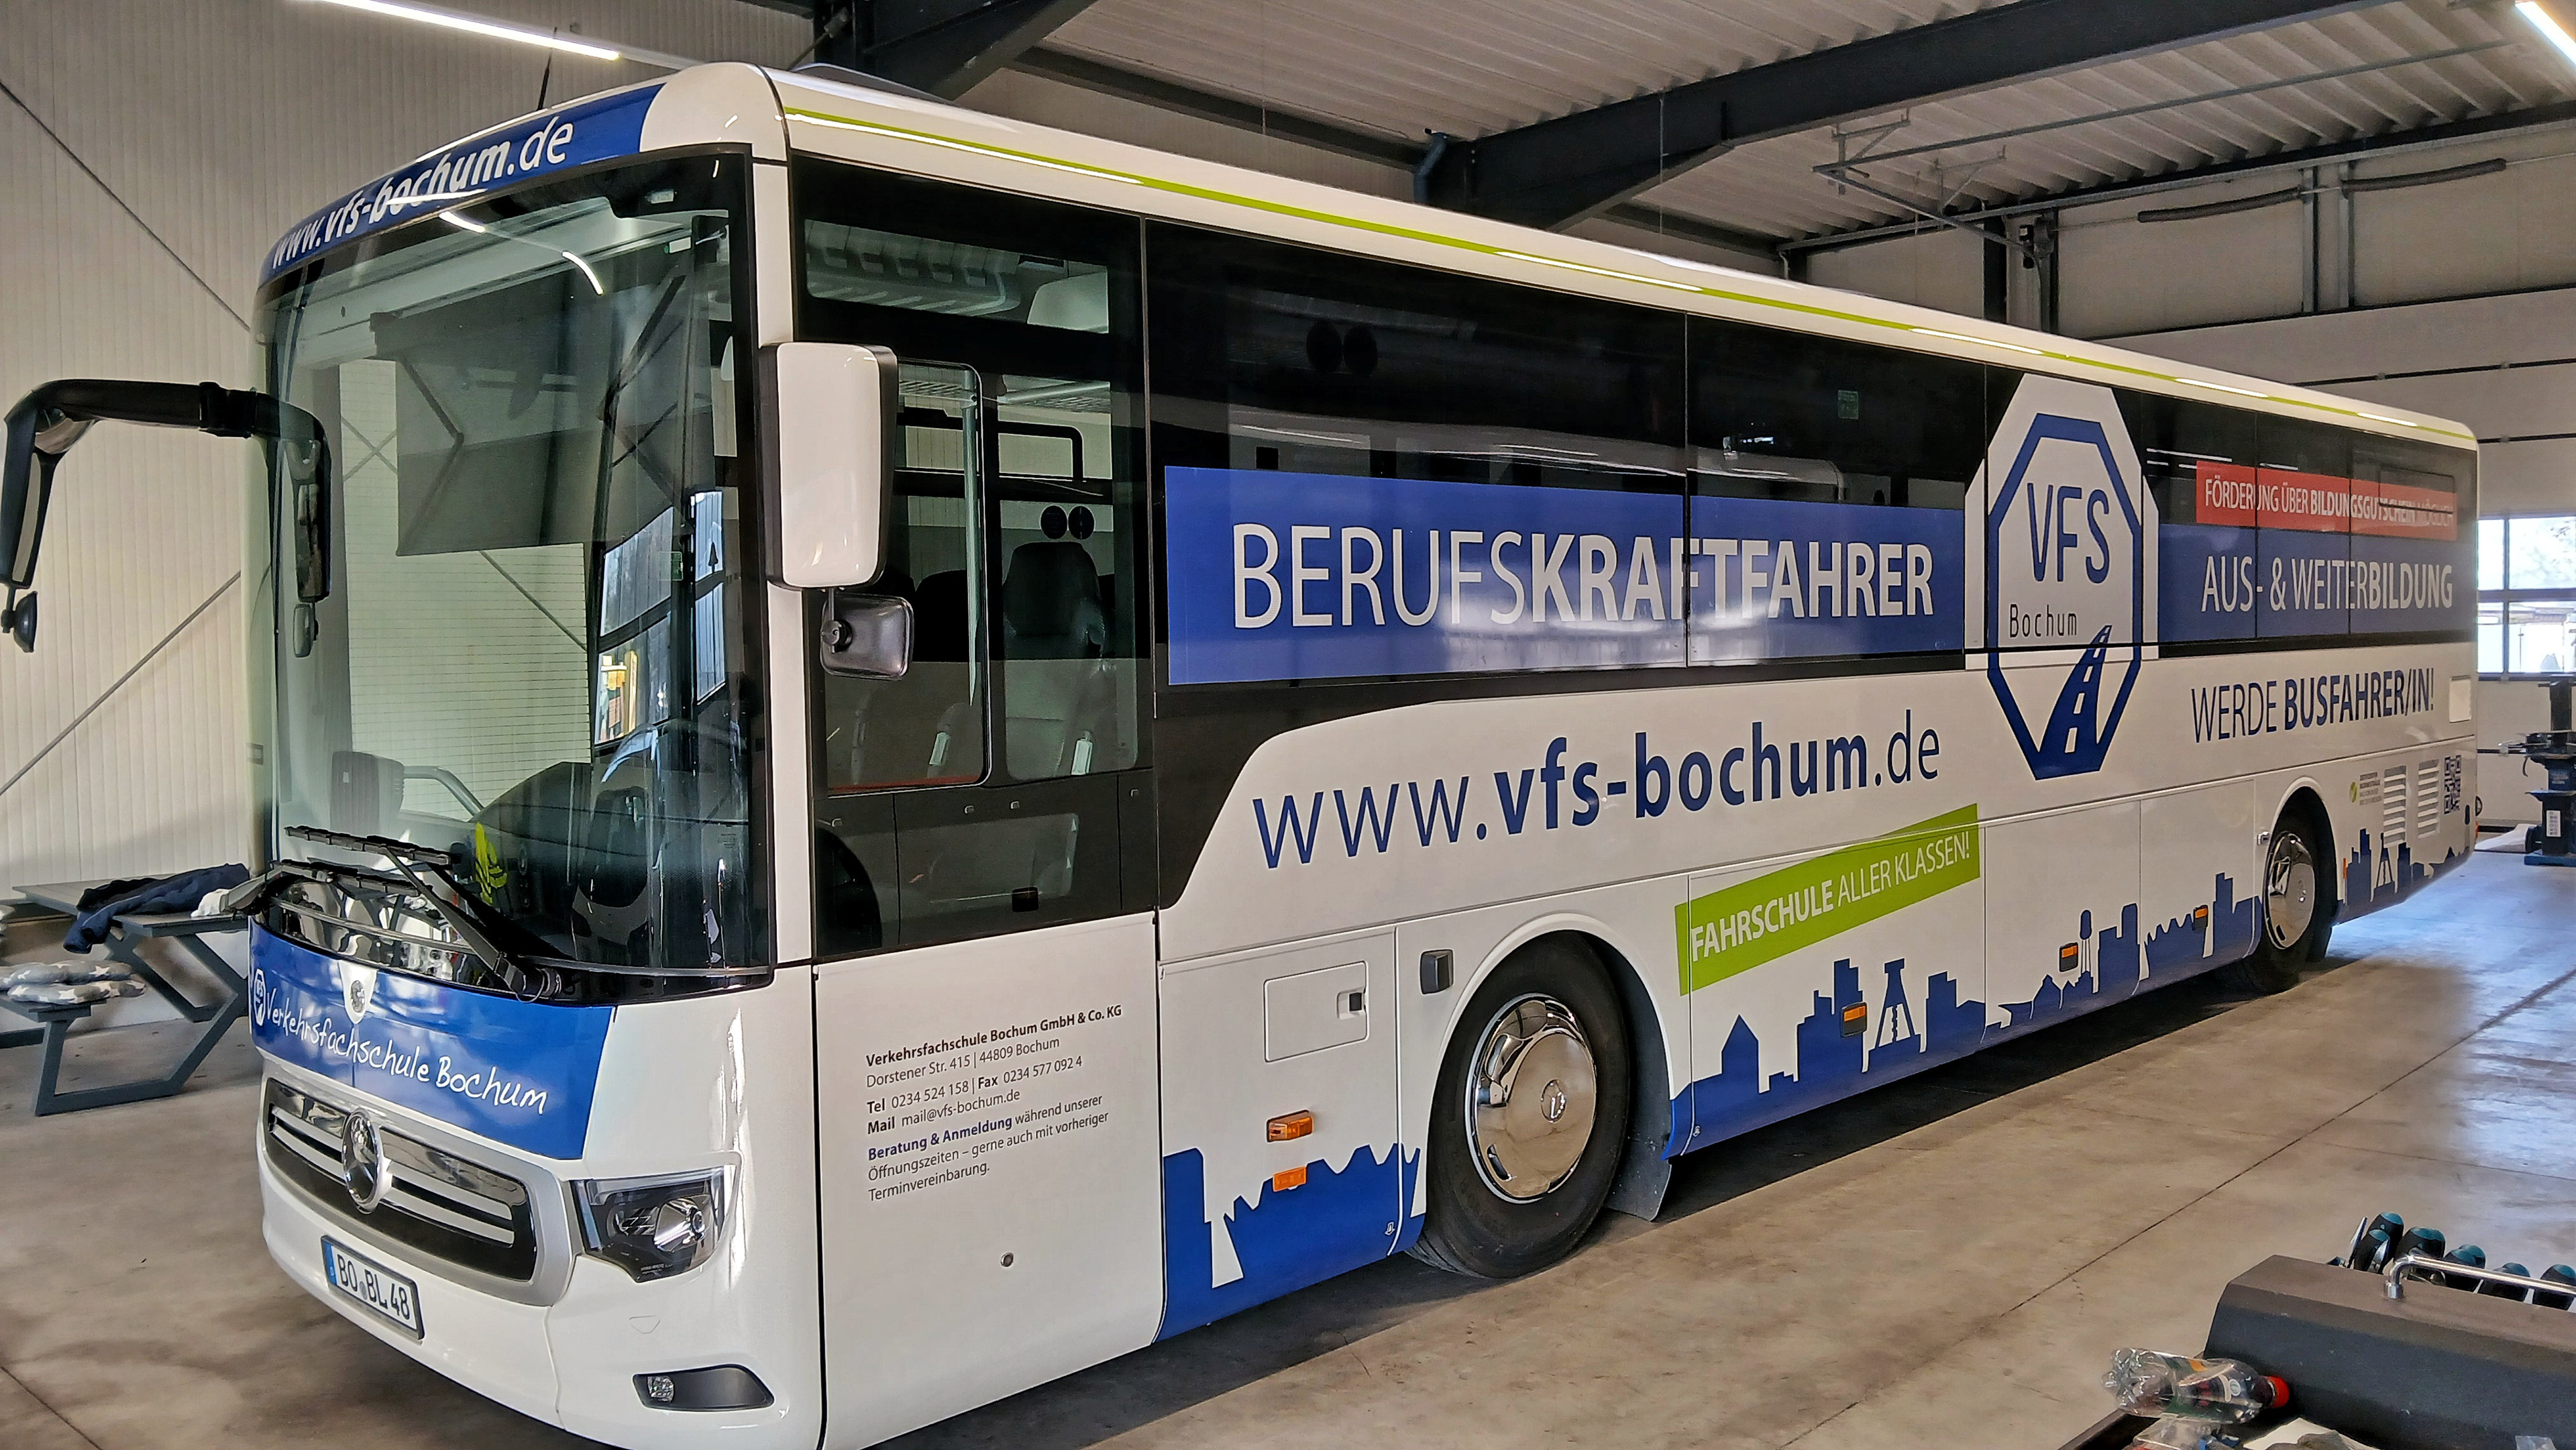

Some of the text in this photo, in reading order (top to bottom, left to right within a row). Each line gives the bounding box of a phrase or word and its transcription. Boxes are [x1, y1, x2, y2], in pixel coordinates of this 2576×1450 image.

[272, 116, 574, 268] www.vfs-bochum.de
[2205, 474, 2279, 513] FÖRDERUNG
[2282, 481, 2309, 515] ÜBER
[2027, 482, 2110, 584] VFS
[1232, 523, 1934, 628] BERUFSKRAFTFAHRER
[2201, 556, 2453, 612] AUS- & WEITERBILDUNG
[2009, 604, 2078, 638] Bochum
[2191, 668, 2434, 743] WERDE BUSFAHRER/IN!
[1252, 709, 1940, 870] www.vfs-bochum.de
[1690, 831, 1971, 962] FAHRSCHULE ALLER KLASSEN!
[267, 987, 548, 1115] Verkehrsfachschule Bochum
[865, 1004, 1122, 1067] Verkehrsfachschule Bochum GmbH & Co. KG
[867, 1066, 926, 1088] Dorstener
[929, 1061, 947, 1075] Str.
[949, 1054, 971, 1070] 415
[979, 1045, 1014, 1064] 44809
[1016, 1038, 1060, 1056] Bochum
[867, 1098, 885, 1115] Tel
[891, 1091, 921, 1109] 0234
[924, 1086, 945, 1102] 524
[949, 1080, 969, 1096] 158
[978, 1076, 998, 1090] Fax
[1003, 1067, 1030, 1084] 0234
[1032, 1061, 1052, 1078] 577
[1054, 1057, 1074, 1072] 092
[1075, 1055, 1083, 1067] 4
[867, 1088, 1020, 1135] Mail mail@vfs-bochum.de
[868, 1095, 1103, 1161] Beratung & Anmeldung während unserer
[868, 1149, 959, 1181] Öffnungszeiten
[972, 1138, 1005, 1159] gerne
[1007, 1129, 1033, 1147] auch
[1035, 1124, 1054, 1139] mit
[1055, 1112, 1109, 1134] vorheriger
[868, 1162, 990, 1201] Terminvereinbarung.
[337, 1253, 411, 1320] BO BL 48
